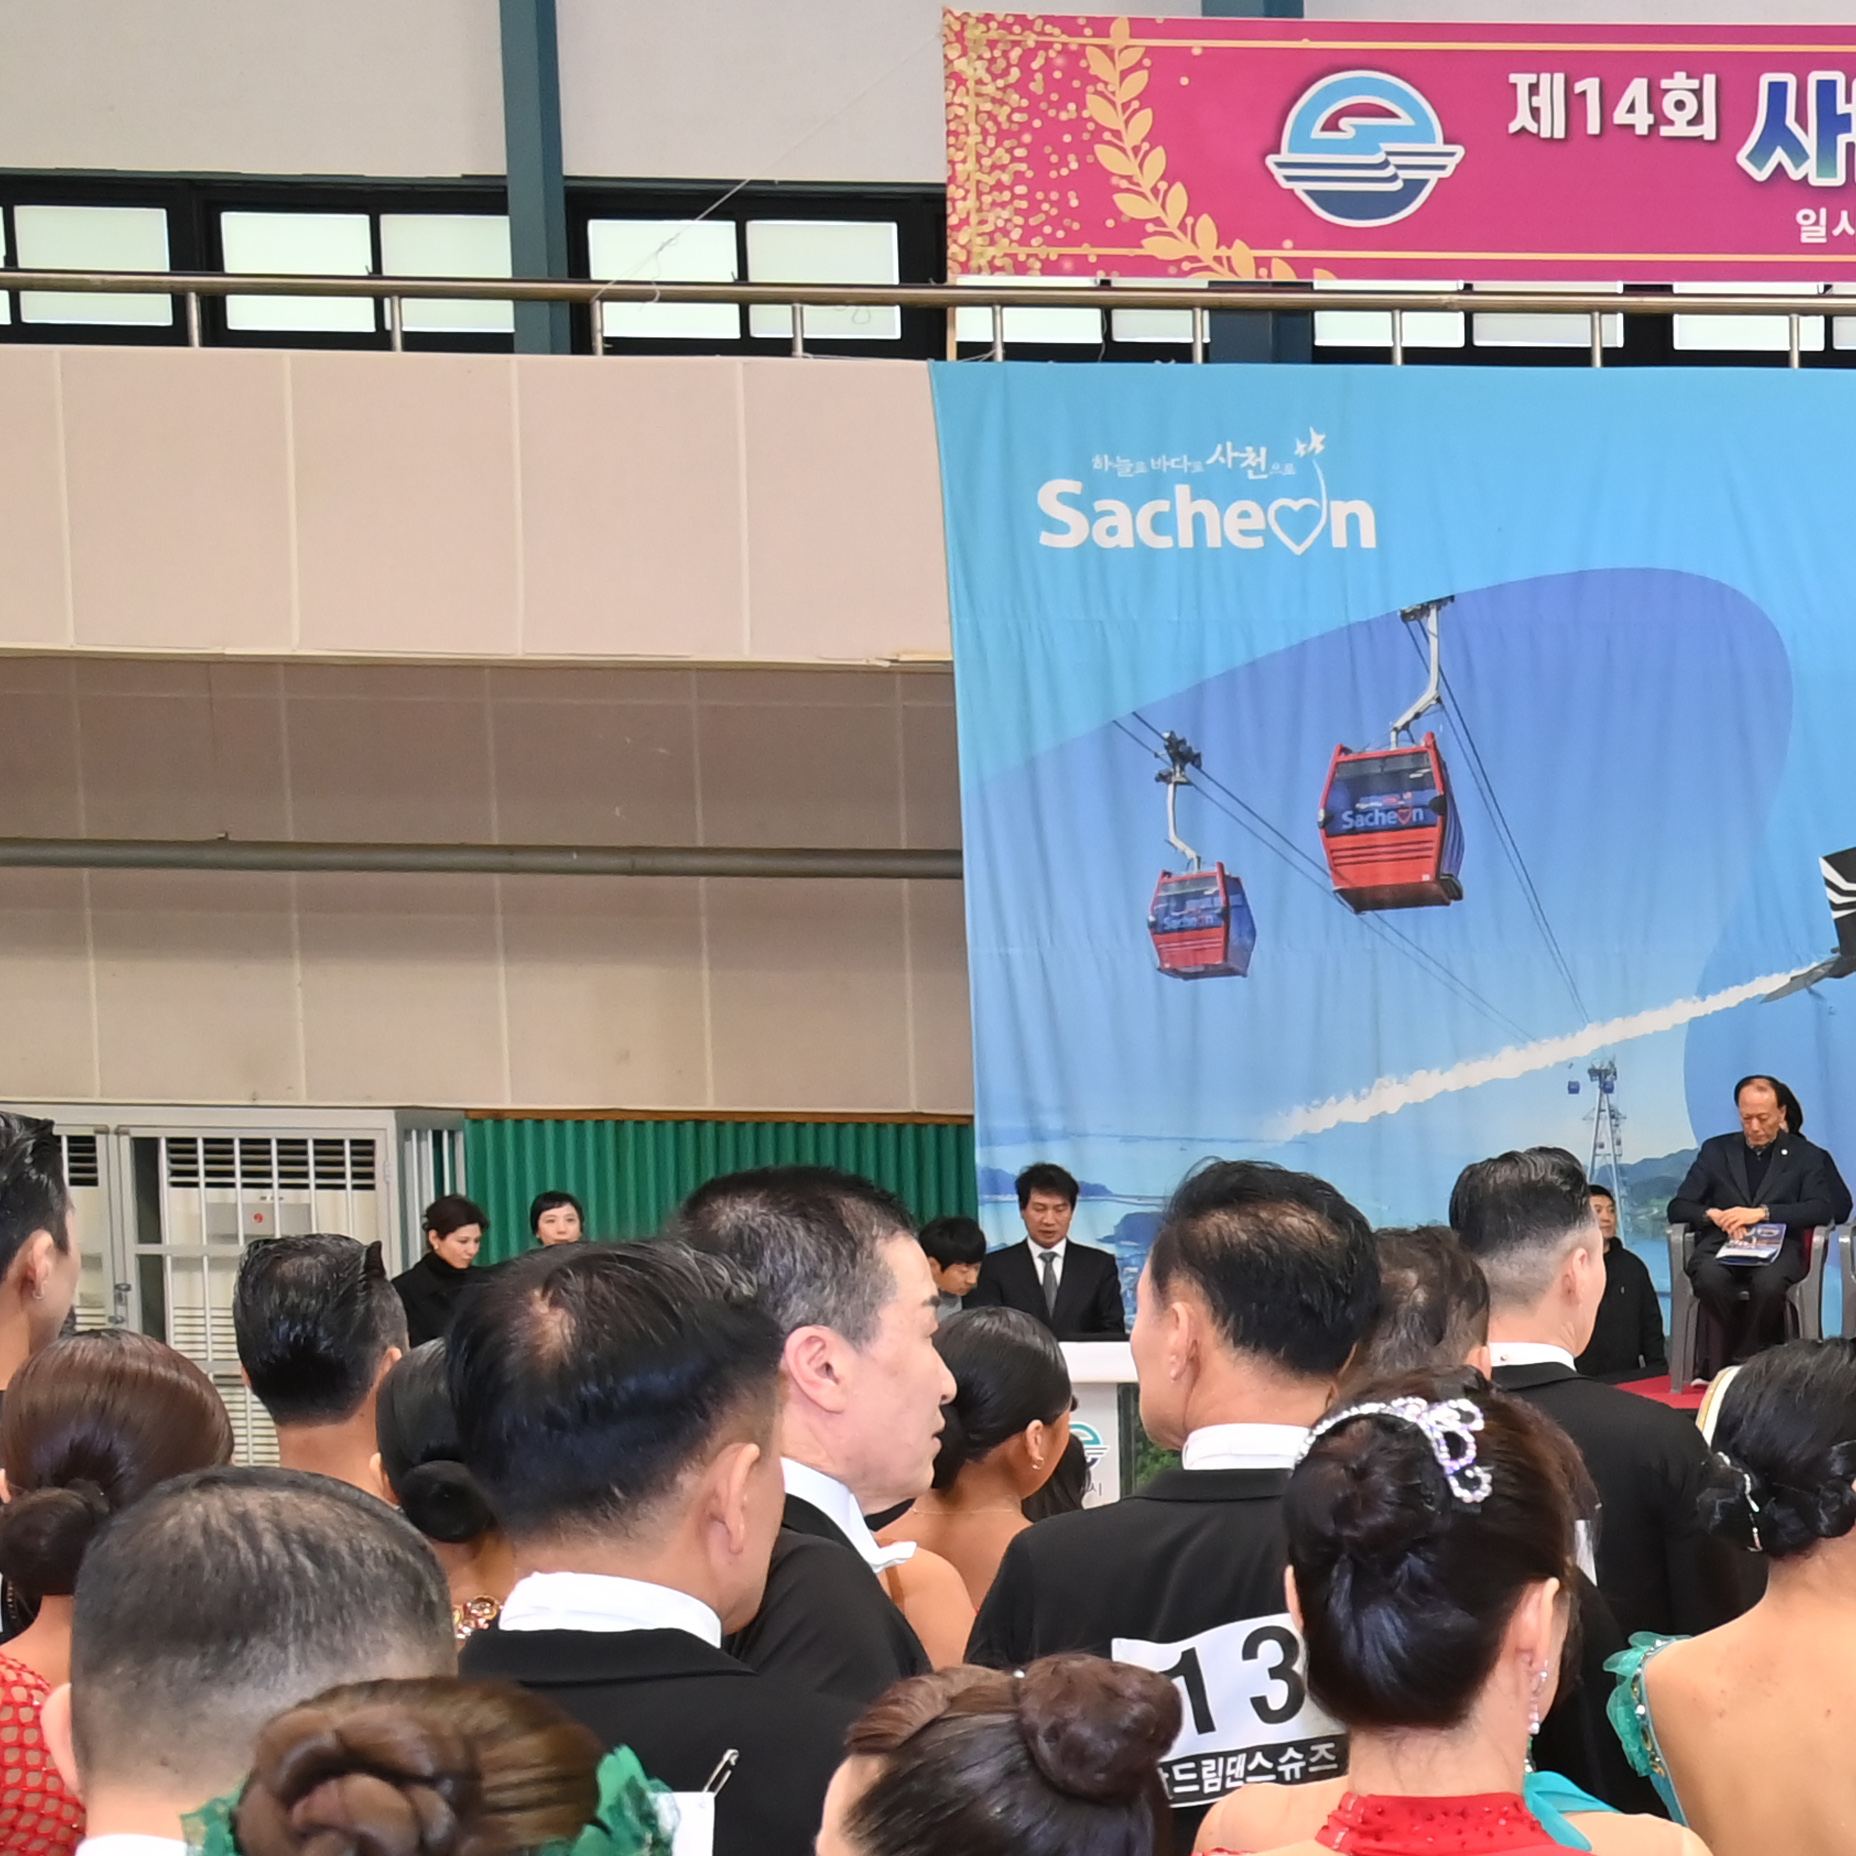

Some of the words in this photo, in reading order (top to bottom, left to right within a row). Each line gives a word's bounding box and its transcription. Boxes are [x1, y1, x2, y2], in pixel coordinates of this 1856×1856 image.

[1507, 72, 1718, 141] 제14회
[1167, 1624, 1306, 1736] 13
[1162, 1740, 1339, 1799] 드림댄스슈즈
